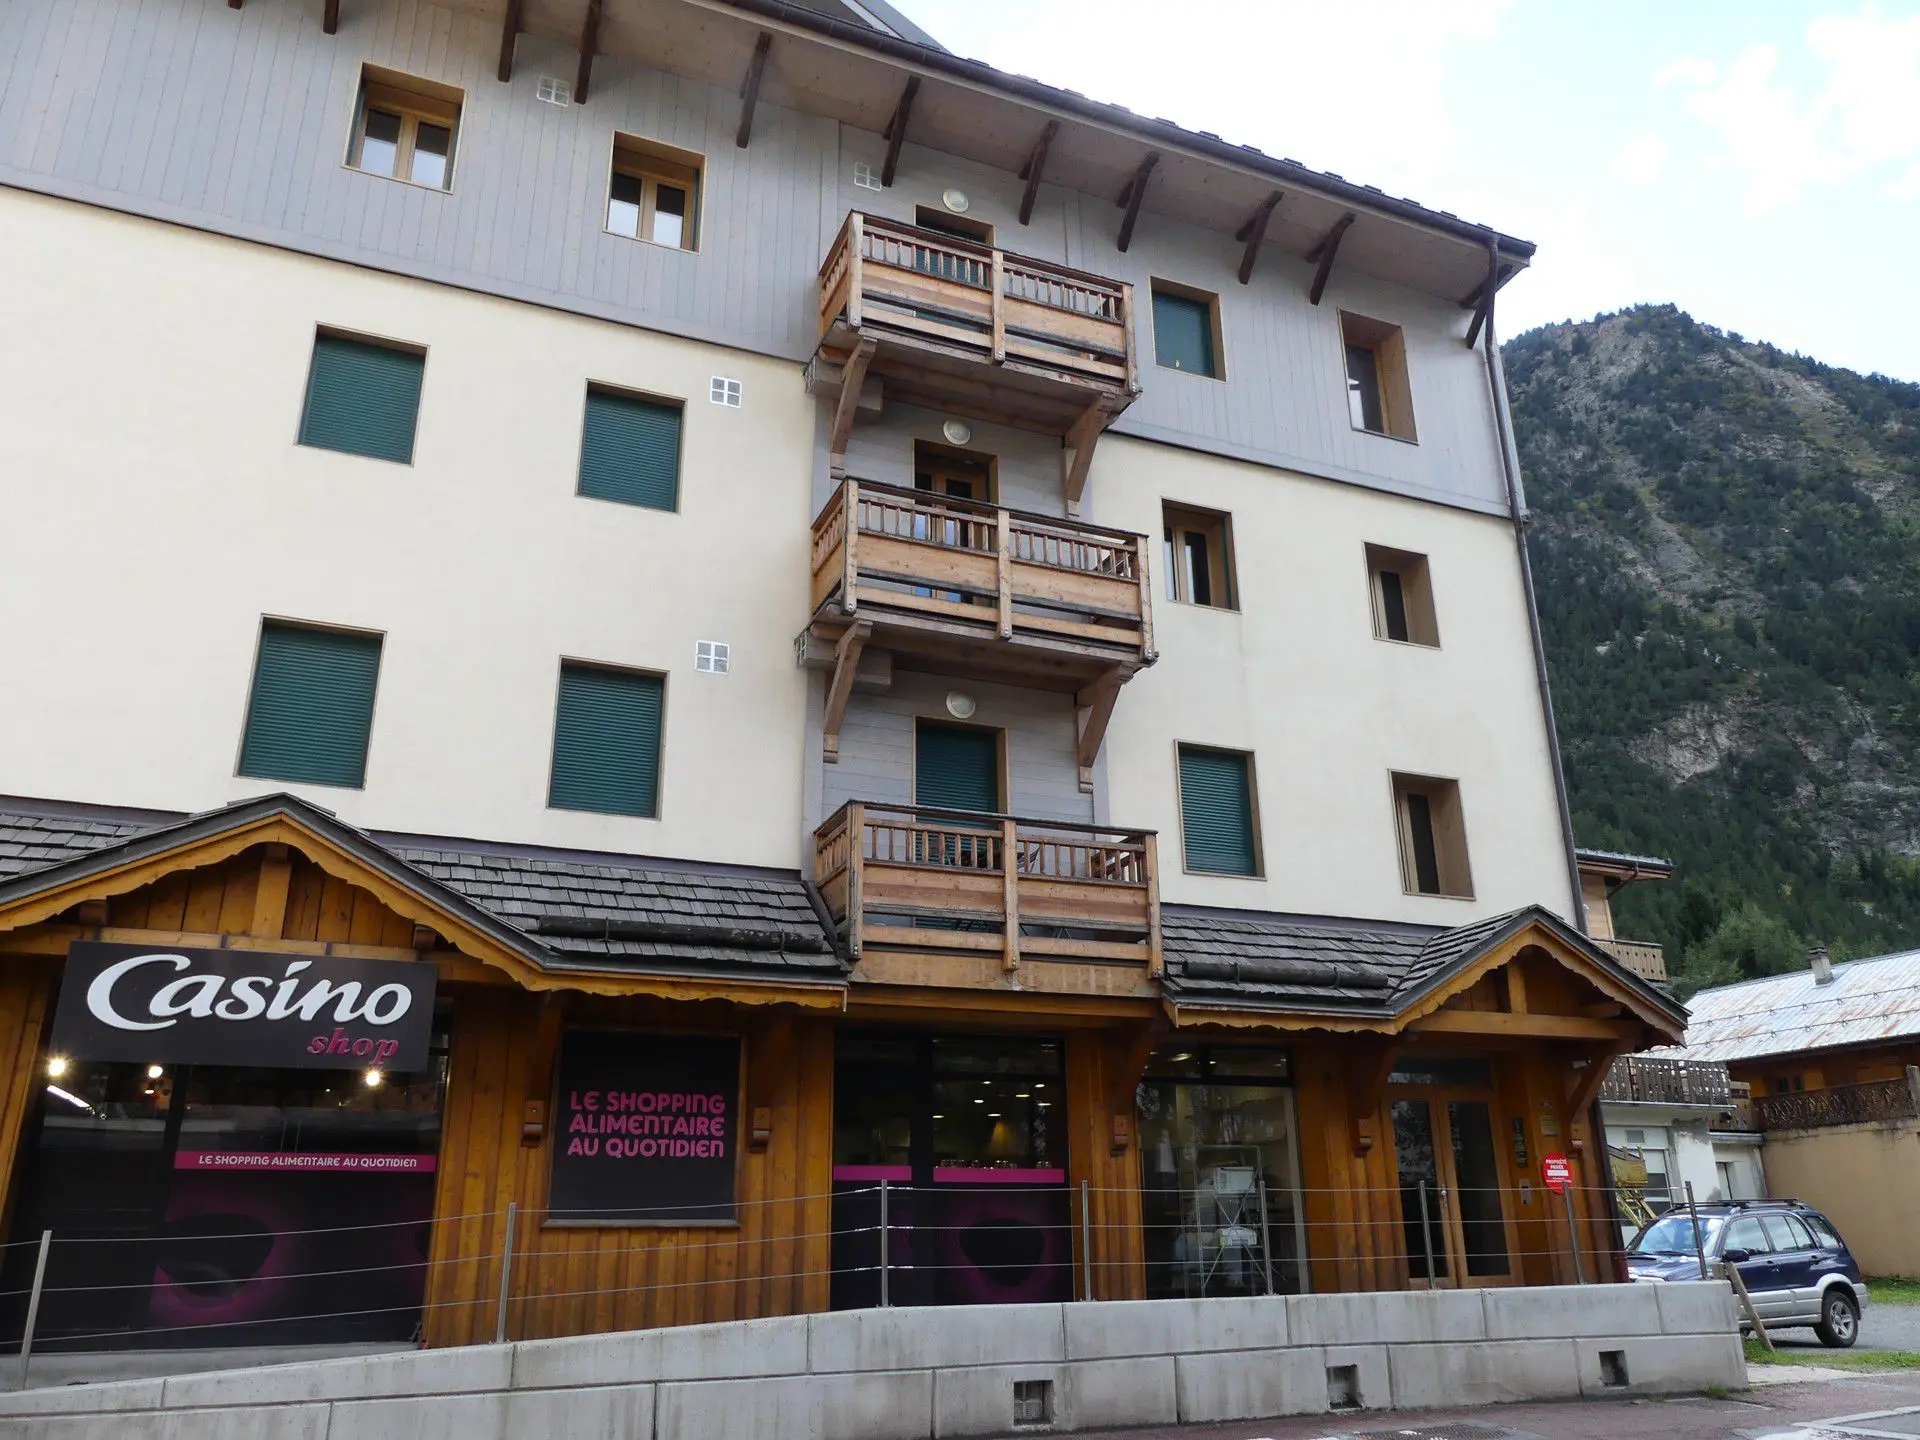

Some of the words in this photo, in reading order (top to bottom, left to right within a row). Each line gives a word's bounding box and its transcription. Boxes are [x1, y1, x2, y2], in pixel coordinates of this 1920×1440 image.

[87, 953, 412, 1031] Casino
[307, 1027, 399, 1065] shop
[569, 1091, 600, 1111] LE
[605, 1092, 726, 1114] SHOPPING
[569, 1113, 725, 1137] ALIMENTAIRE
[567, 1137, 599, 1157] AU
[605, 1138, 724, 1159] QUOTIDIEN
[199, 1155, 213, 1165] LE
[215, 1155, 270, 1166] SHOPPING
[271, 1156, 341, 1167] ALIMENTAIRE
[343, 1157, 358, 1167] AU
[360, 1158, 417, 1168] QUOTIDIEN
